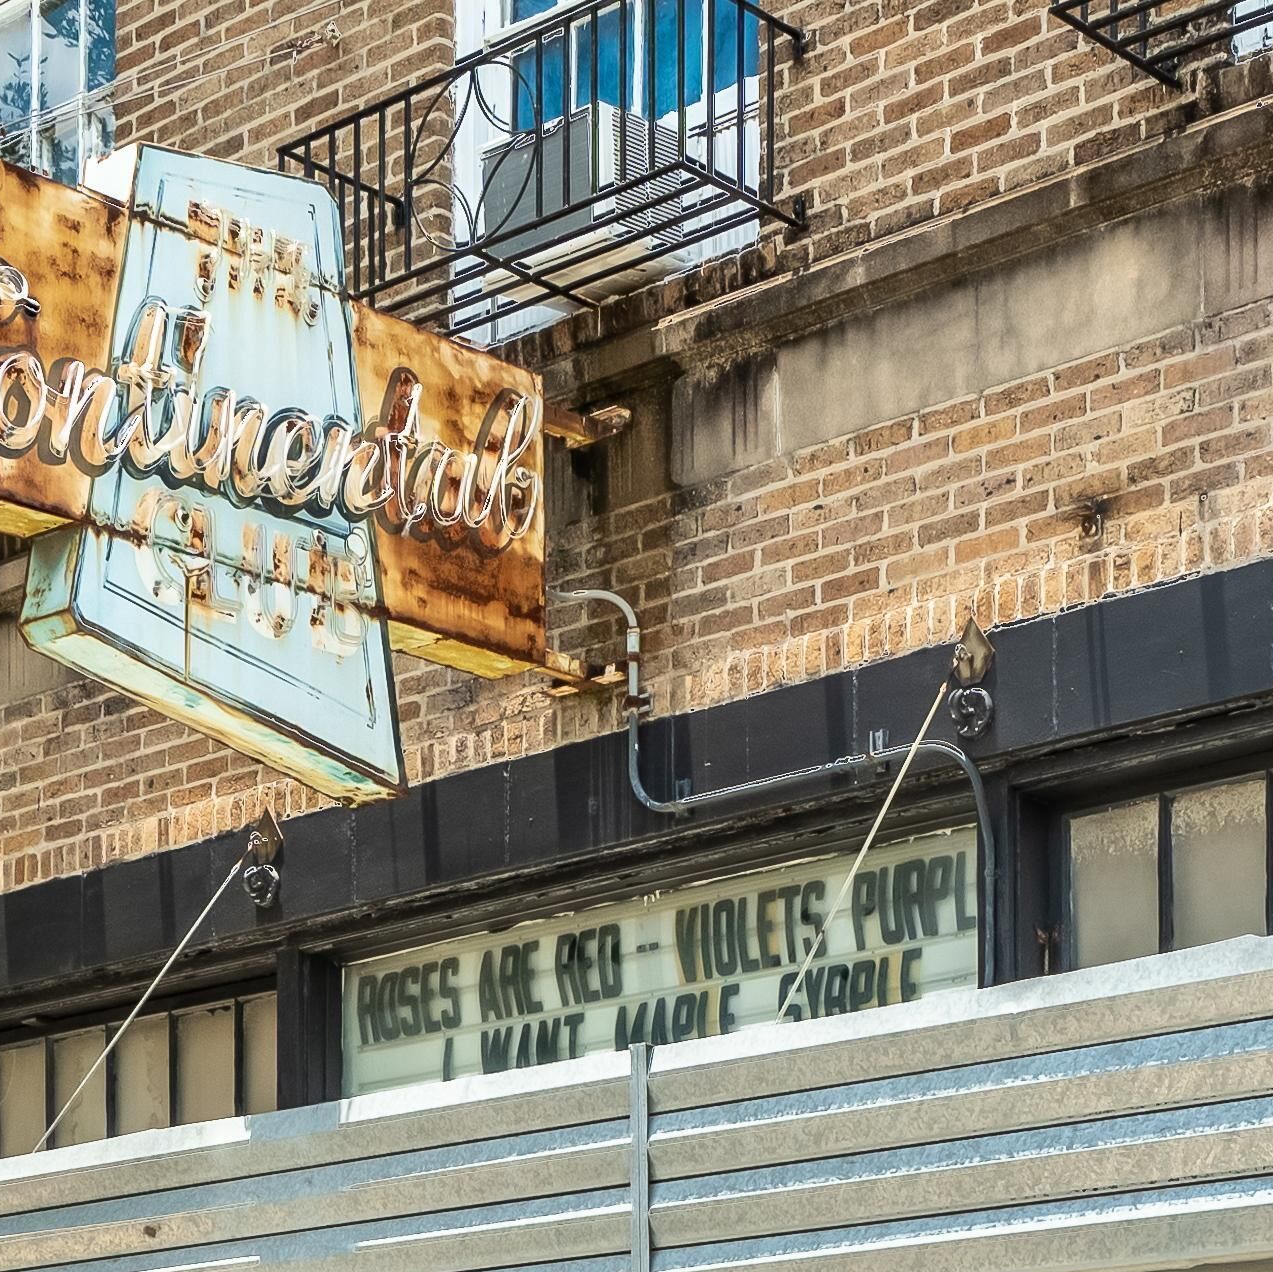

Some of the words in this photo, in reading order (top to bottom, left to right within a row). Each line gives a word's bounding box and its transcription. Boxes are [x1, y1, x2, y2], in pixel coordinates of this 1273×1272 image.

[135, 488, 369, 656] CLUB
[356, 957, 462, 1045] ROSES
[478, 940, 544, 1023] ARE
[555, 923, 622, 1007] RED
[675, 880, 827, 983] VIOLETS
[481, 1013, 585, 1075] WANT
